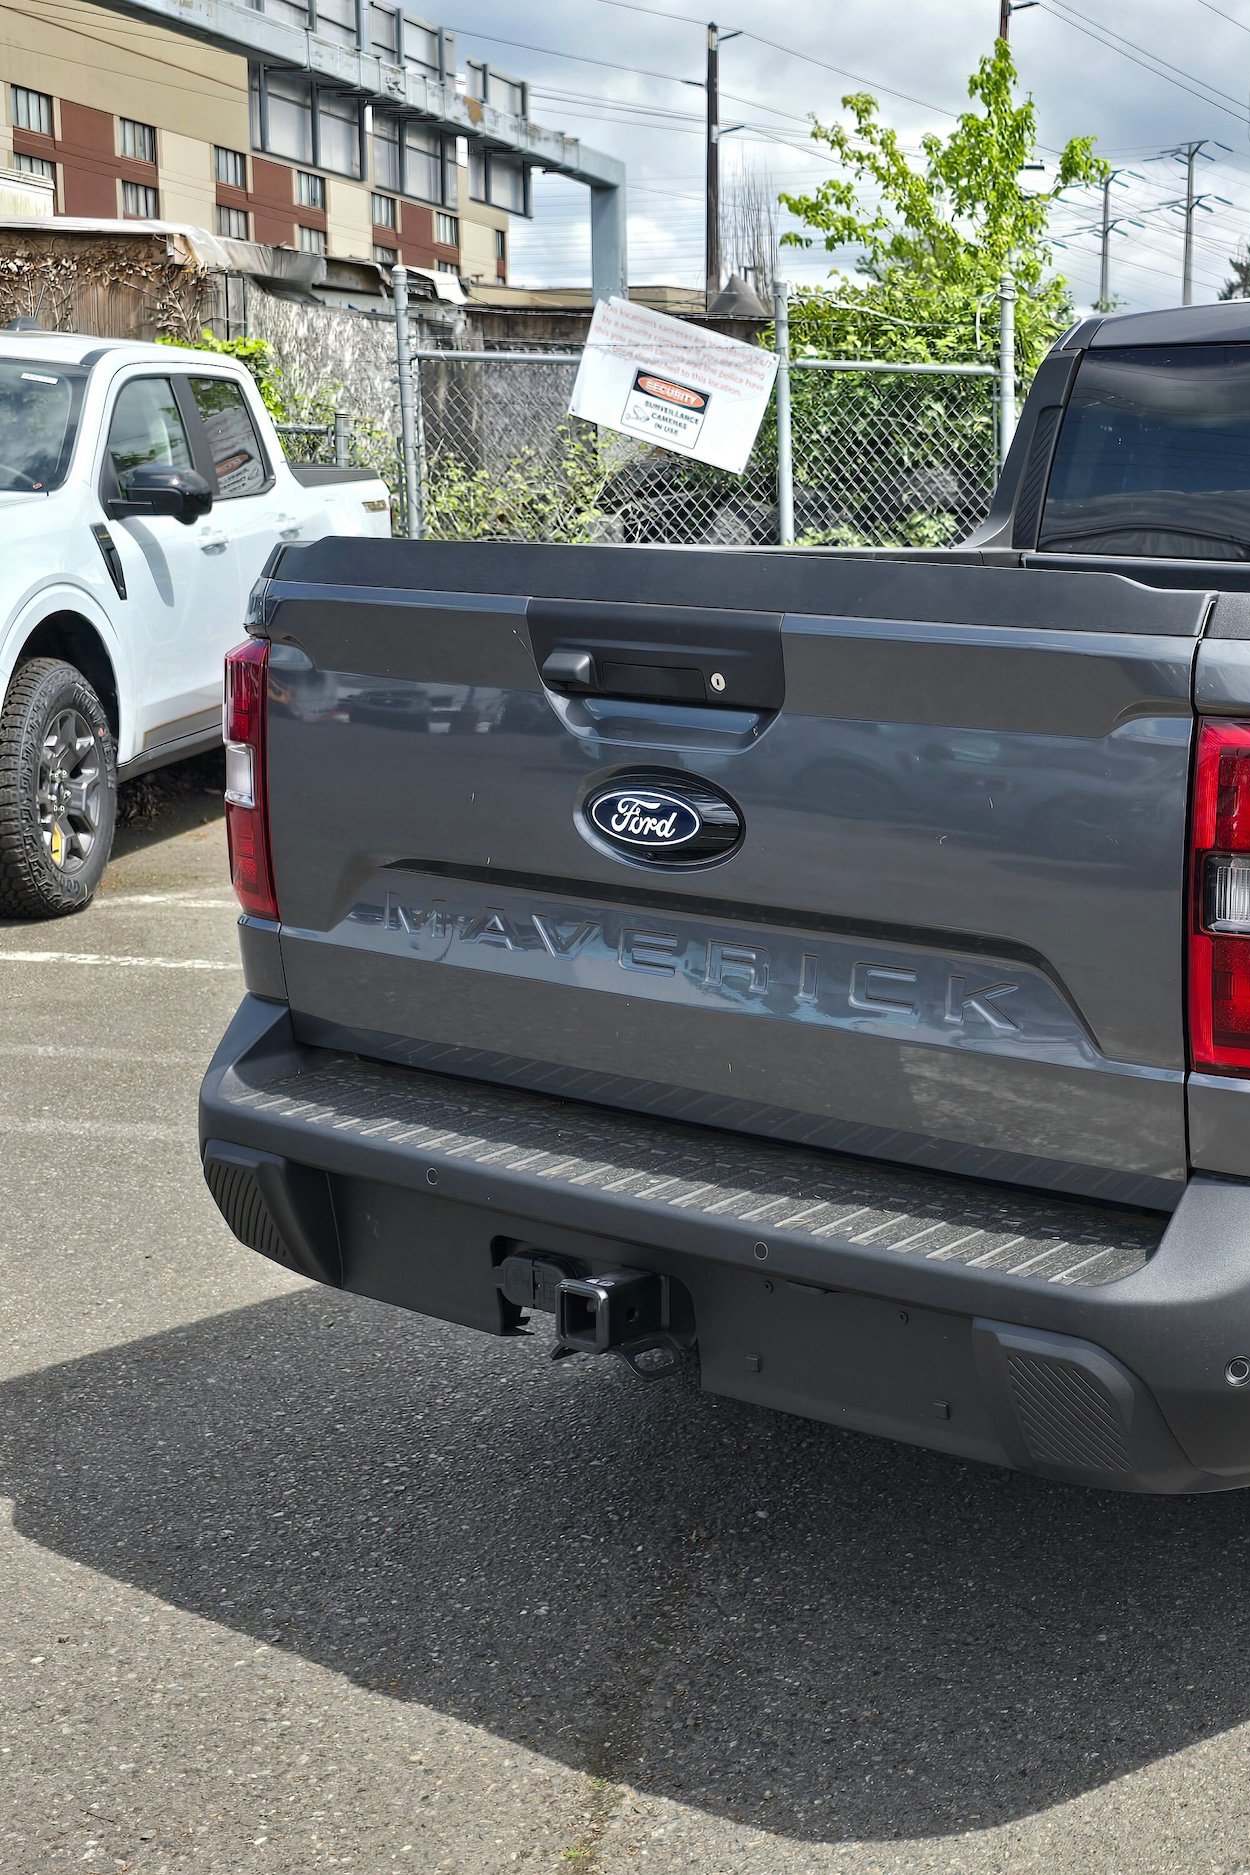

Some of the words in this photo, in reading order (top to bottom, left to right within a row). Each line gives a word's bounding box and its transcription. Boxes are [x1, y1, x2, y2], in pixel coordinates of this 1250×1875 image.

[645, 379, 697, 406] SECURITY
[644, 399, 699, 425] SURVEILLANCE
[663, 425, 678, 435] USE
[611, 797, 677, 839] Ford
[384, 891, 1020, 1032] MAVERICK
